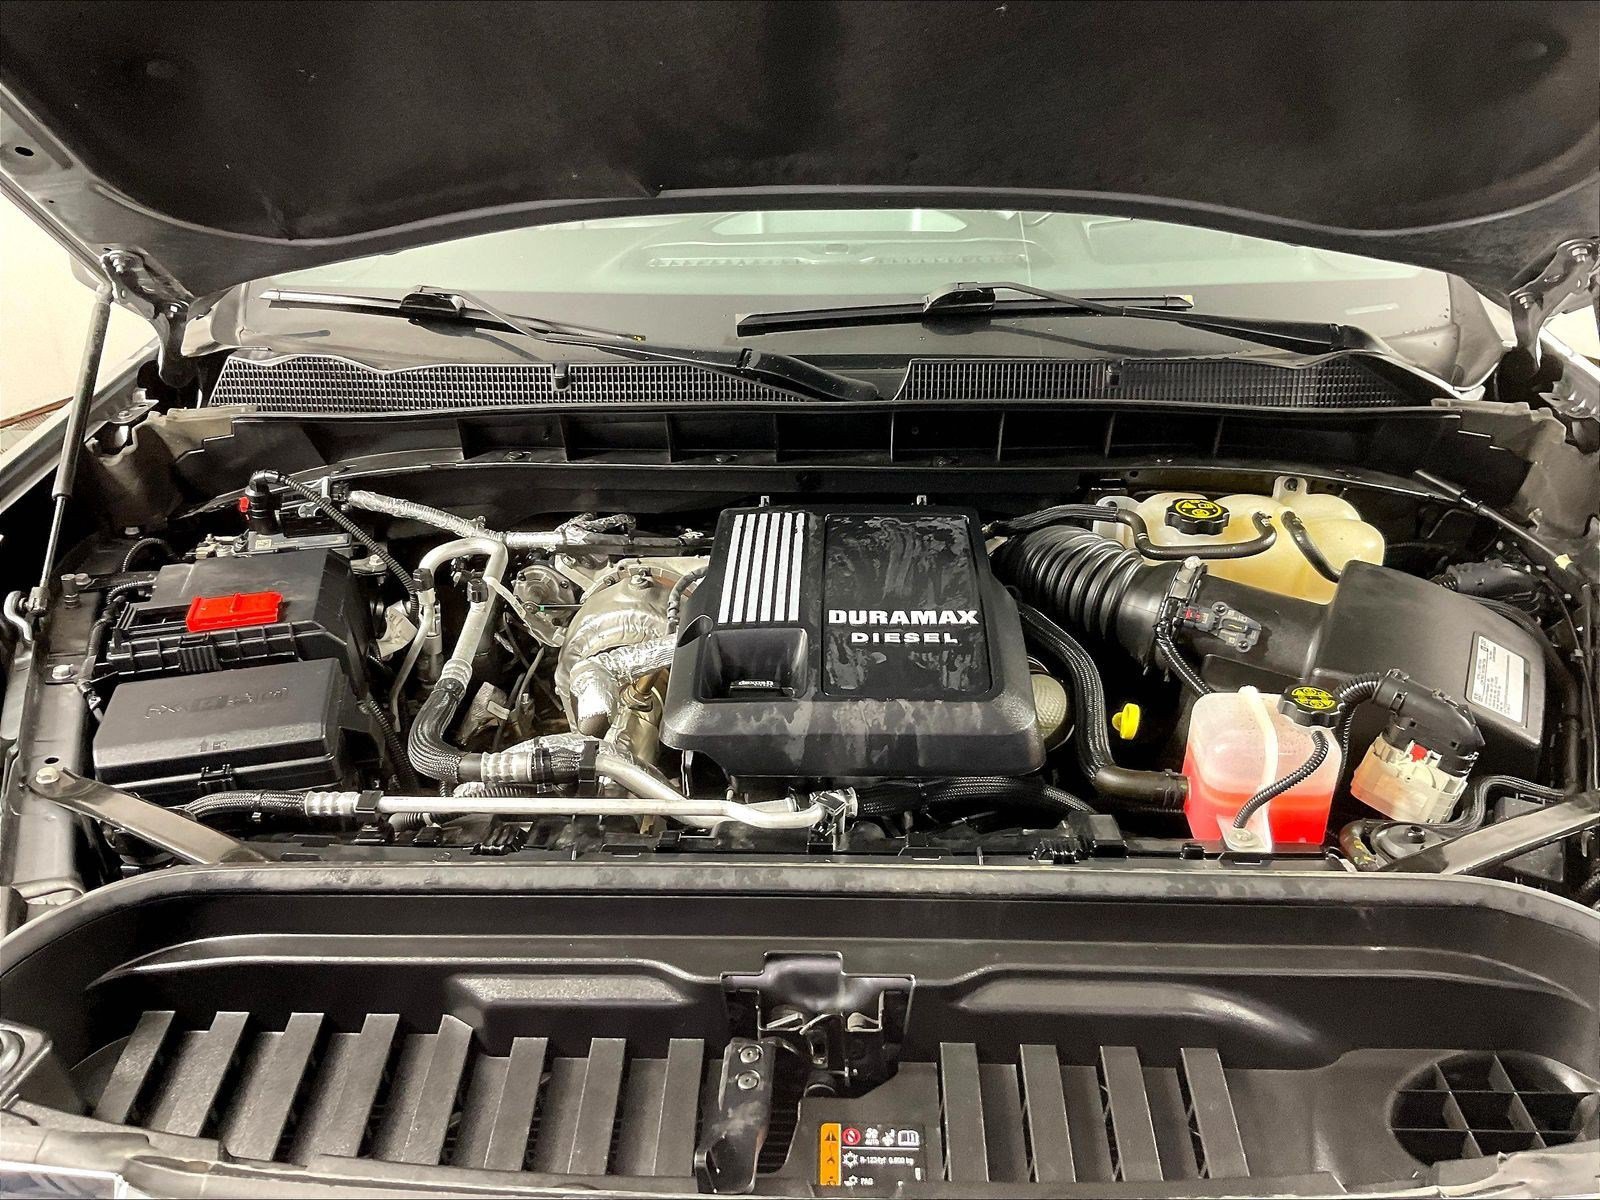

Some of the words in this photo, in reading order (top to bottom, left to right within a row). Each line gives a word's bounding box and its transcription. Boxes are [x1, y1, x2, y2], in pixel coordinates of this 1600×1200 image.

[828, 609, 980, 625] DURAMAX
[851, 632, 959, 644] DIESEL
[860, 1178, 874, 1187] PAG
